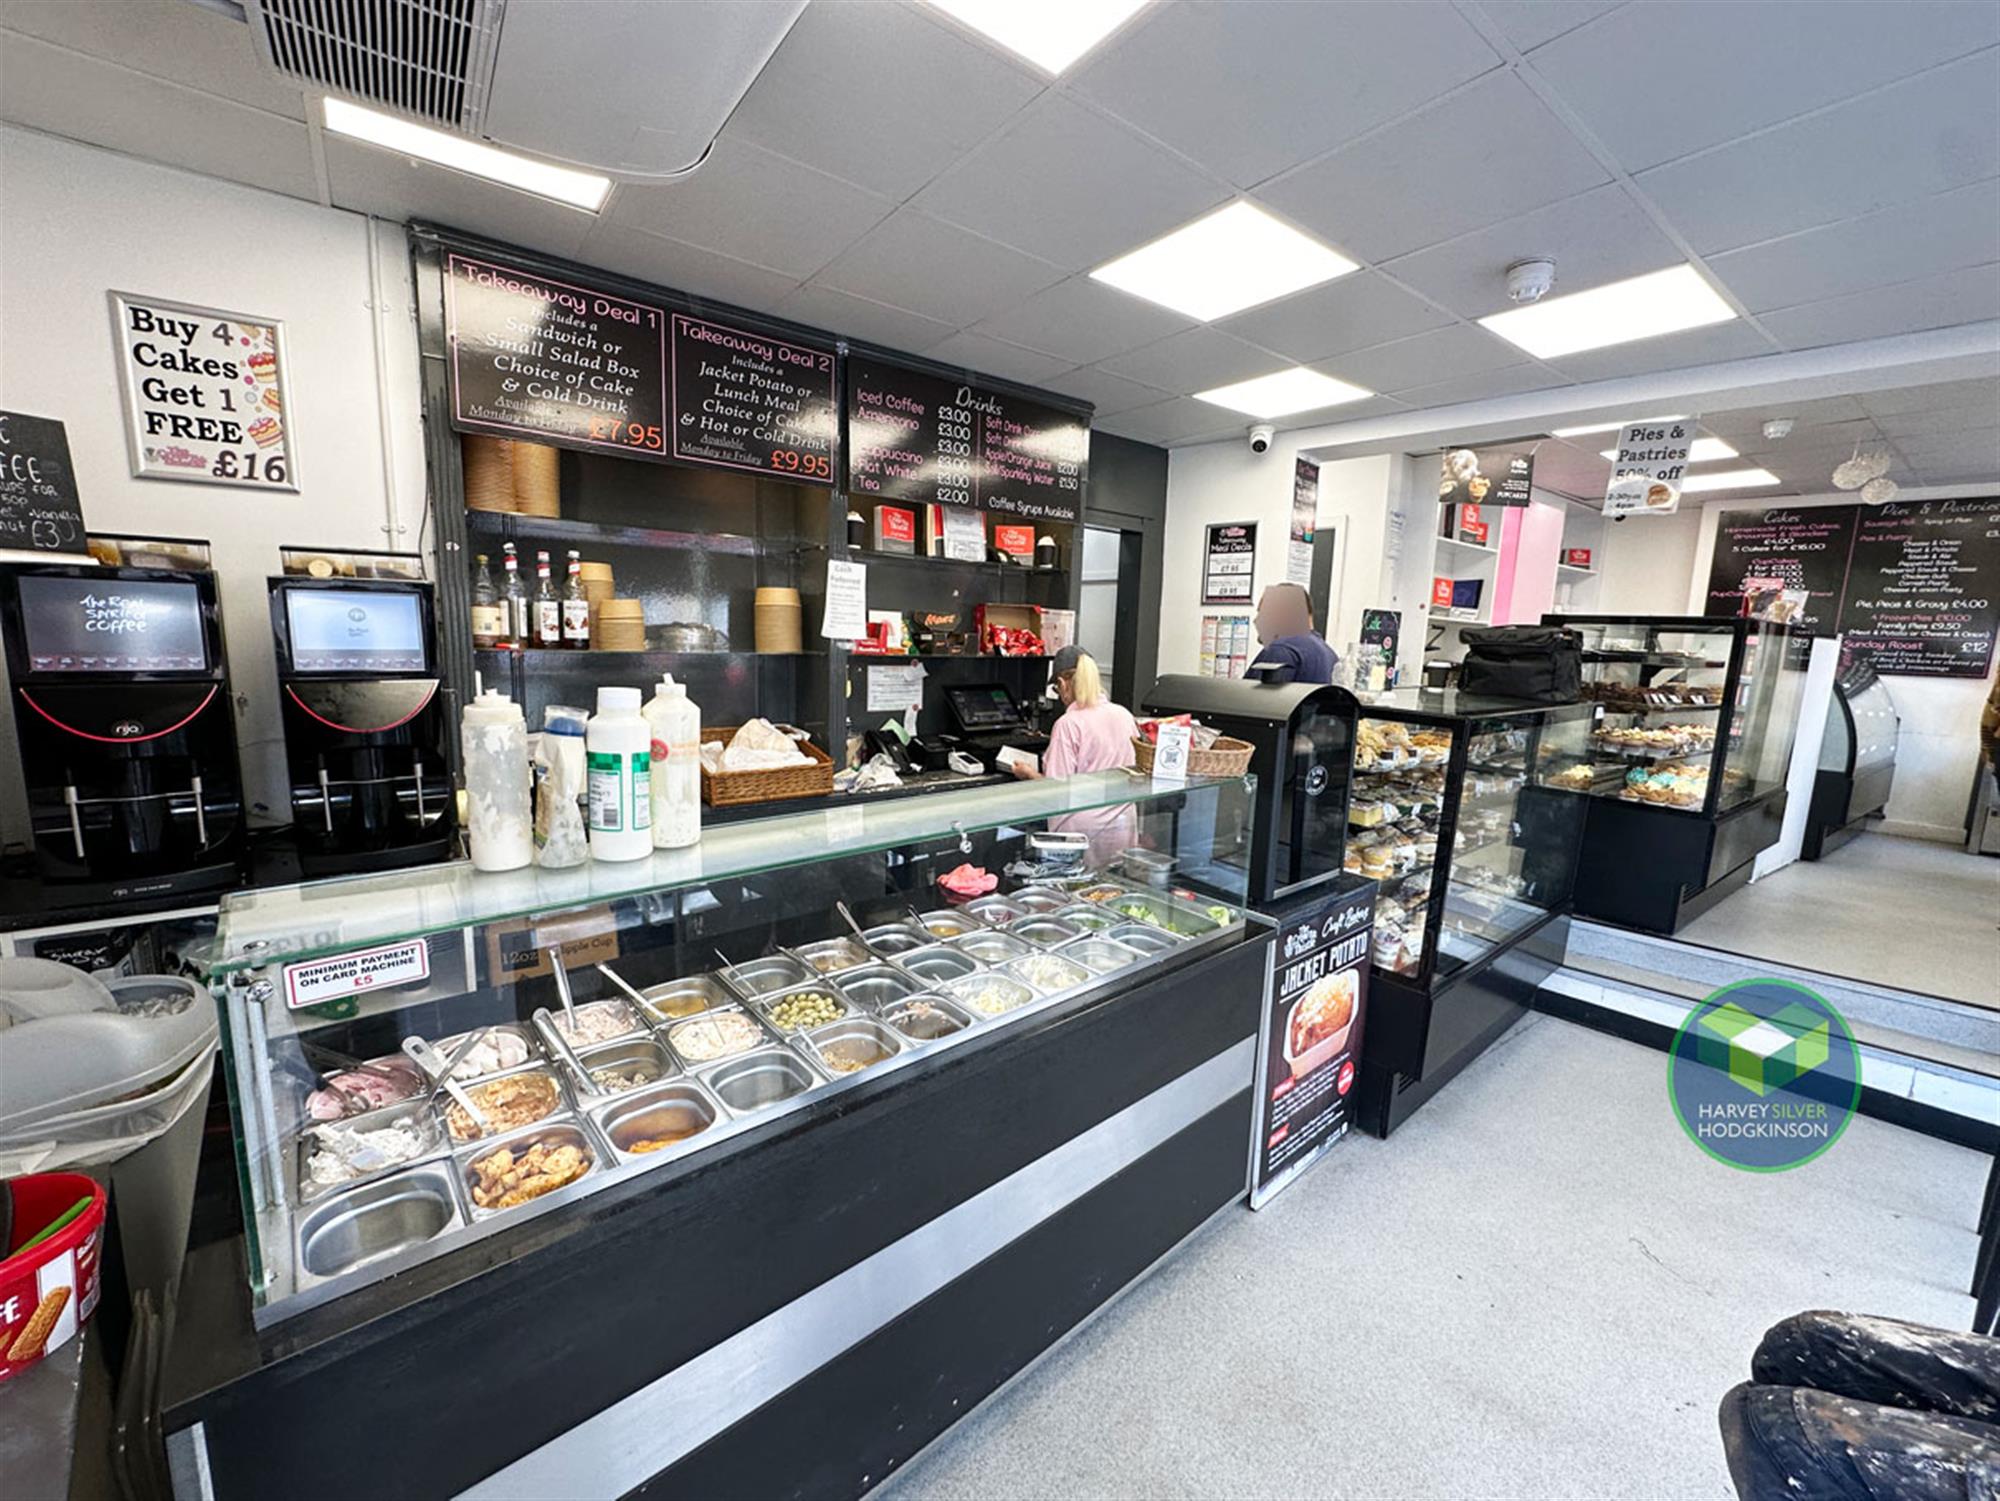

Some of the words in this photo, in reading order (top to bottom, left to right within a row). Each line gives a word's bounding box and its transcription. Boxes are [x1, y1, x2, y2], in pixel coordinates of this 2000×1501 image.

[462, 263, 587, 315] Takeaway
[593, 299, 640, 325] Deal
[647, 312, 656, 329] 1
[129, 306, 199, 346] Buy
[212, 323, 234, 346] 4
[530, 305, 586, 329] Includes
[589, 321, 598, 331] a
[505, 315, 598, 349] Sandwich
[602, 341, 623, 355] or
[678, 320, 773, 362] Takeaway
[778, 348, 814, 368] Deal
[818, 357, 830, 372] 2
[133, 342, 239, 379] Cakes
[485, 332, 543, 357] Small
[549, 346, 601, 370] Salad
[606, 358, 640, 379] Box
[732, 355, 774, 374] Includes
[776, 368, 784, 376] a
[493, 354, 560, 381] Choice
[565, 369, 586, 388] of
[590, 375, 635, 396] Cake
[699, 361, 745, 383] Jacket
[750, 373, 794, 395] Potato
[797, 387, 812, 398] or
[142, 377, 205, 408] Get
[219, 388, 237, 412] 1
[501, 377, 520, 392] &
[526, 381, 571, 403] Cold
[577, 391, 628, 415] Drink
[714, 383, 760, 404] Lunch
[764, 395, 800, 412] Meal
[857, 387, 883, 405] Iced
[885, 394, 925, 415] Coffee
[938, 406, 971, 425] £3.00
[955, 386, 1003, 416] Drinks
[144, 410, 243, 444] FREE
[468, 404, 521, 424] Monday
[702, 399, 753, 420] Choice
[756, 411, 772, 427] of
[985, 415, 1002, 429] Soft
[1003, 420, 1022, 434] Drink
[588, 417, 663, 449] £7.95
[680, 413, 695, 426] &
[700, 416, 729, 433] Hot
[732, 425, 749, 436] or
[752, 427, 785, 444] Cold
[789, 433, 830, 451] Drink
[938, 422, 971, 440] £3.00
[985, 431, 1002, 444] Soft
[1629, 428, 1664, 442] Pies
[1670, 425, 1685, 439] &
[680, 441, 720, 458] Monday
[723, 449, 733, 459] to
[734, 451, 763, 465] Friday
[938, 439, 970, 456] £3.00
[1618, 446, 1687, 462] Pastries
[212, 449, 286, 482] £16
[770, 450, 830, 476] £9.95
[858, 458, 880, 474] Flat
[883, 462, 917, 480] White
[938, 471, 970, 488] £3.00
[938, 455, 970, 473] £3.00
[1657, 465, 1684, 480] off
[858, 475, 880, 490] Tea
[937, 488, 969, 504] £2.00
[989, 496, 1015, 510] Coffee
[1017, 500, 1042, 516] Syrups
[1044, 505, 1075, 519] Available
[1764, 510, 1800, 523] Cakes
[1876, 600, 1901, 608] Peas
[1915, 600, 1949, 610] Gravy
[1952, 599, 1989, 609] £4.00
[1877, 622, 1906, 630] Family
[1931, 622, 1962, 630] £9.50
[1844, 640, 1886, 650] Sunday
[1888, 641, 1924, 650] Roast
[1960, 642, 1989, 653] £12
[502, 950, 539, 965] 12oz
[591, 937, 613, 952] Cup
[299, 958, 357, 978] MINIMUM
[361, 948, 416, 964] PAYMENT
[300, 977, 319, 987] ON
[323, 968, 357, 982] CARD
[361, 956, 415, 973] MACHINE
[1280, 951, 1327, 996] JACKET
[1329, 931, 1368, 971] POTATO
[353, 975, 373, 986] £5
